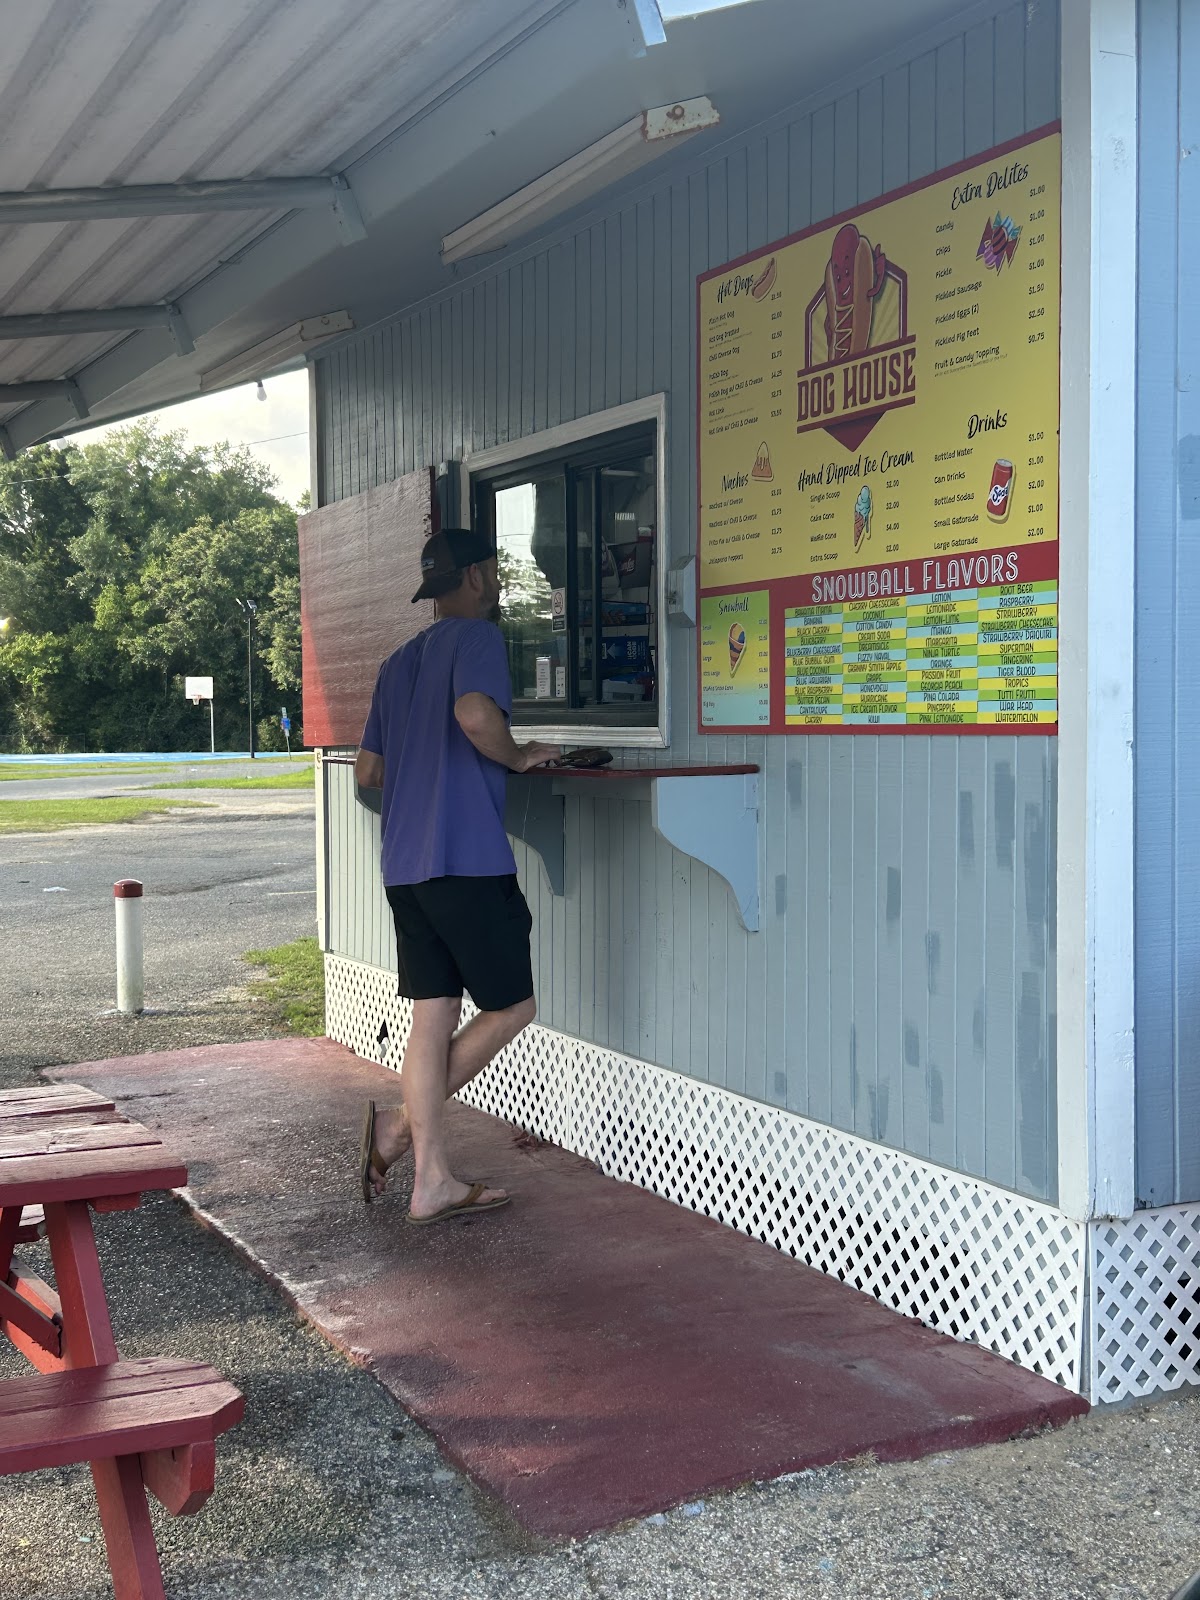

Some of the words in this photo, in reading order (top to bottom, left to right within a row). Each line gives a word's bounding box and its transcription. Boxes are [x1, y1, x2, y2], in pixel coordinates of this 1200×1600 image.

[952, 183, 982, 210] Extra
[986, 163, 1028, 198] Delites
[1030, 185, 1045, 197] $1.00
[1030, 210, 1044, 221] $1.00
[936, 221, 954, 233] Candy
[1029, 234, 1044, 246] $1.00
[936, 245, 950, 256] Chips
[1029, 259, 1044, 270] $1.00
[936, 268, 952, 279] Pickle
[717, 280, 732, 303] Hot
[734, 275, 753, 296] Dogs
[935, 289, 955, 302] Pickled
[956, 281, 982, 295] Sausage
[1029, 283, 1044, 295] $1.50
[935, 313, 955, 324] Pickled
[957, 307, 970, 319] Eggs
[1028, 308, 1044, 319] $2.50
[935, 335, 955, 347] Pickled
[956, 333, 965, 342] Pig
[967, 327, 979, 338] Feet
[1028, 332, 1044, 343] $0.75
[935, 360, 948, 370] Fruit
[950, 358, 954, 366] &
[956, 353, 974, 363] Candy
[976, 346, 999, 359] Topping
[797, 372, 834, 422] DOG
[843, 348, 916, 410] HOUSE
[967, 409, 1007, 439] Drinks
[1029, 432, 1044, 442] $1.00
[935, 450, 955, 461] Bottled
[957, 447, 973, 457] Water
[1029, 456, 1043, 465] $1.00
[798, 464, 823, 491] Hand
[826, 455, 861, 484] Dipped
[863, 456, 878, 477] Ice
[881, 451, 914, 473] Cream
[721, 472, 749, 493] Nachos
[934, 475, 945, 484] Can
[947, 471, 965, 481] Drinks
[886, 480, 899, 488] $2.00
[1028, 480, 1044, 489] $2.00
[810, 495, 825, 503] Single
[826, 491, 840, 499] Scoop
[934, 495, 955, 506] Bottled
[956, 493, 974, 502] Sodas
[886, 502, 899, 510] $2.00
[1028, 504, 1043, 513] $1.00
[934, 518, 950, 527] Small
[952, 514, 979, 524] Gatorade
[886, 523, 899, 531] $4.00
[1028, 527, 1043, 537] $2.00
[886, 544, 899, 552] $2.00
[934, 540, 950, 550] Large
[951, 537, 978, 547] Gatorade
[812, 567, 914, 603] SNOWBALL
[923, 552, 1018, 590] FLAVORS
[1001, 586, 1015, 595] ROOT
[1017, 584, 1033, 593] BEER
[932, 593, 951, 603] LEMON
[1000, 596, 1034, 607] RASPBERRY
[719, 597, 749, 615] Snowball
[849, 602, 867, 611] CHERRY
[869, 598, 900, 609] CHEESECAKE
[927, 604, 956, 614] LEMONADE
[816, 606, 832, 614] MAMA
[863, 610, 885, 620] COCONUT
[997, 607, 1037, 619] STRAWBERRY
[924, 615, 959, 625] LEMON-LIME
[981, 621, 1017, 632] STRAWBERRY
[1019, 618, 1053, 629] CHEESECAKE
[856, 622, 874, 631] COTTON
[876, 620, 892, 629] CANDY
[931, 626, 951, 635] MANGO
[797, 628, 810, 636] BLACK
[813, 626, 830, 634] CHERRY
[858, 632, 876, 641] CREAM
[877, 631, 890, 639] SODA
[983, 632, 1023, 642] STRAWBERRY
[1026, 629, 1052, 639] DAIQUIRI
[801, 637, 826, 646] BLUEBERRY
[926, 637, 957, 646] MARGARITA
[923, 649, 938, 658] NINJA
[940, 648, 960, 657] TURTLE
[1000, 643, 1033, 653] SUPERMAN
[793, 658, 804, 666] BLUE
[805, 657, 822, 665] BUBBLE
[858, 653, 873, 662] FUZZY
[874, 652, 890, 660] NAVAL
[1001, 655, 1033, 664] TANGERINE
[848, 664, 867, 673] GRANNY
[869, 663, 884, 672] SMITH
[886, 662, 901, 670] APPLE
[931, 660, 952, 668] ORANGE
[797, 667, 808, 675] BLUE
[810, 666, 829, 675] COCONUT
[922, 671, 944, 680] PASSION
[946, 669, 961, 678] FRUIT
[998, 667, 1014, 676] TIGER
[1017, 666, 1035, 676] BLOOD
[796, 677, 807, 685] BLUE
[866, 674, 882, 682] GRAPE
[860, 684, 888, 692] HONEYDEW
[921, 682, 943, 691] GEORGIA
[945, 681, 962, 690] PEACH
[1005, 679, 1028, 688] TROPICS
[795, 687, 806, 695] BLUE
[807, 686, 833, 694] RASPBERRY
[998, 690, 1013, 699] TUTTI
[1016, 690, 1035, 699] FRUTTI
[815, 696, 830, 704] PECAN
[861, 694, 888, 703] HURRICANE
[938, 692, 959, 700] COLADA
[800, 706, 827, 714] CANTALOUPE
[861, 705, 878, 713] CREAM
[879, 704, 897, 712] FLAVOR
[927, 703, 955, 712] PINEAPPLE
[1000, 703, 1014, 711] WAR
[1017, 701, 1033, 710] HEAD
[805, 716, 822, 724] CHERRY
[868, 715, 880, 723] KIWI
[920, 715, 932, 723] PINK
[934, 714, 963, 723] LEMONADE
[995, 713, 1038, 722] WATERMELON
